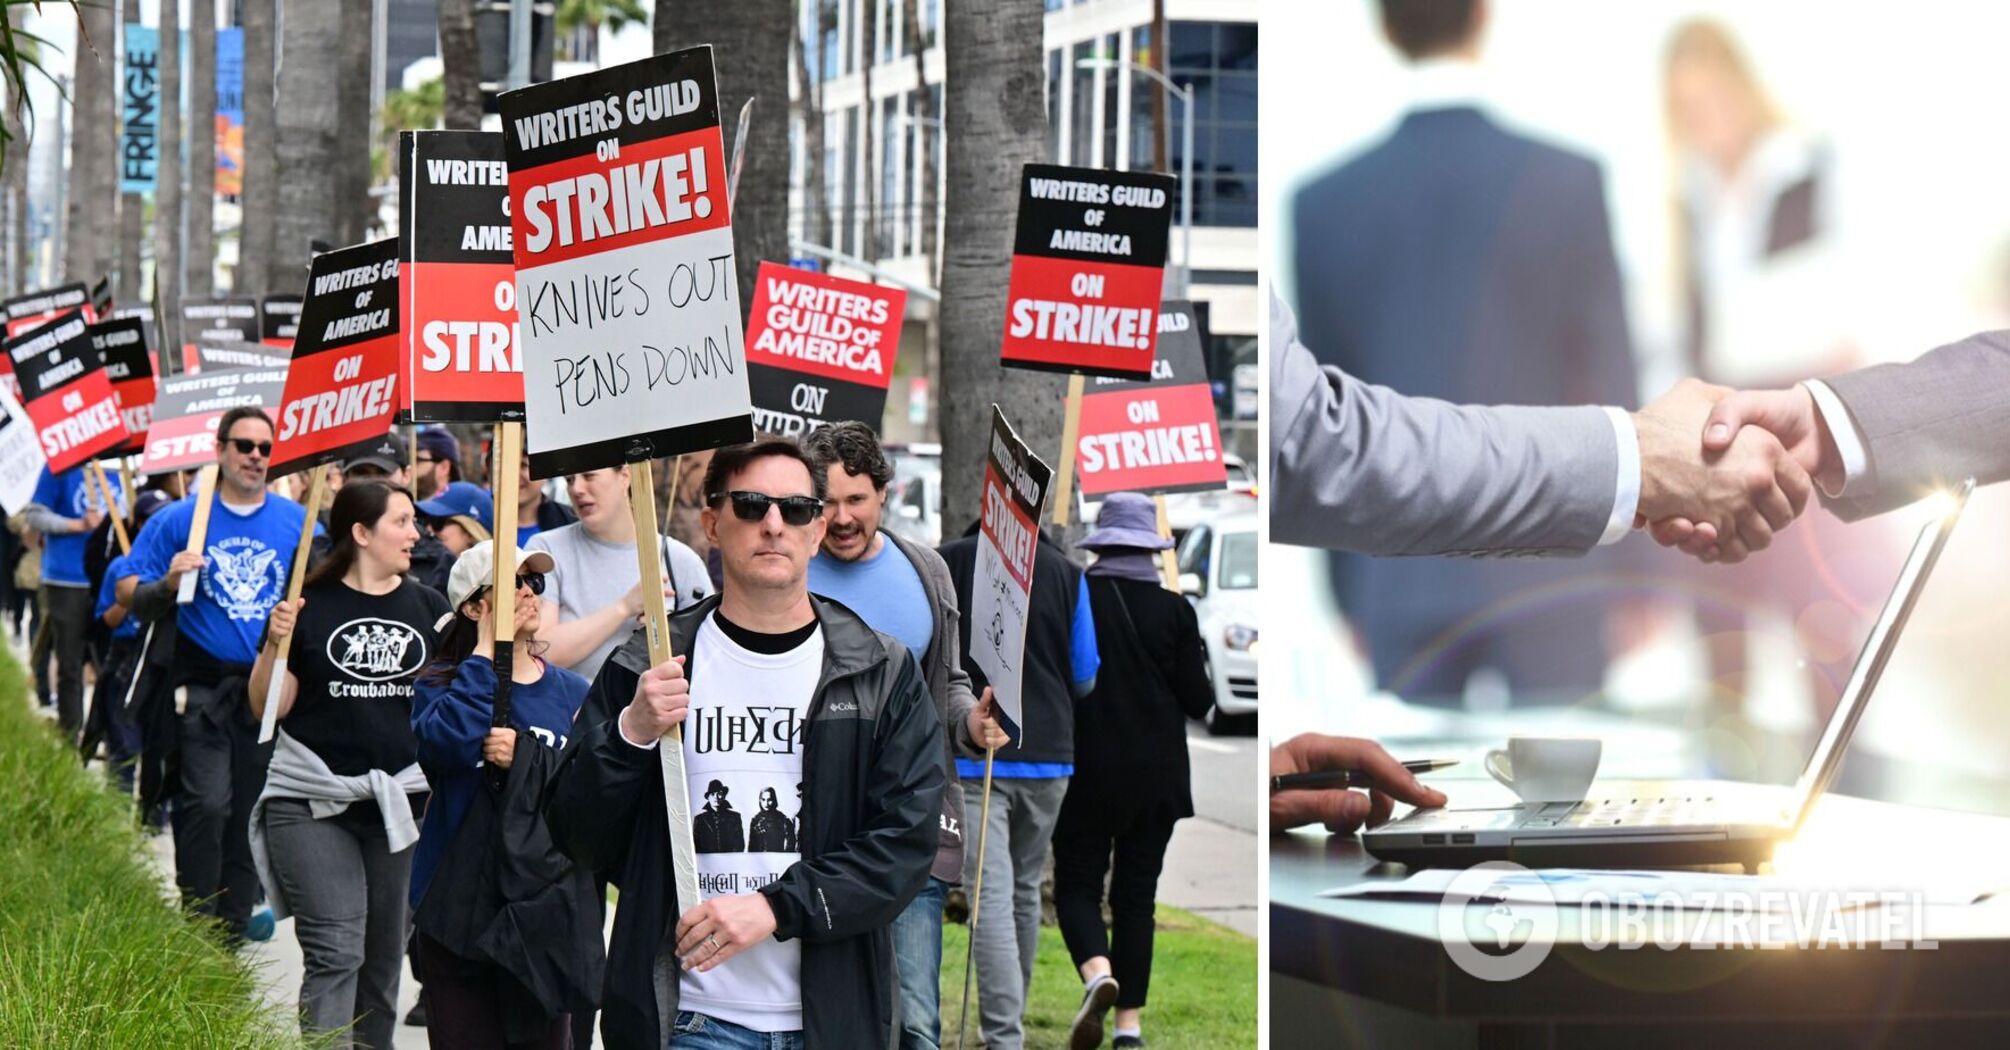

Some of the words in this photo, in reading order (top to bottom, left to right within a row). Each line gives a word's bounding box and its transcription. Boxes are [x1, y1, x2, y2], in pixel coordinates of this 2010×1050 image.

[125, 51, 156, 181] FRINGE
[515, 95, 622, 151] WRITERS
[626, 79, 701, 125] GUILD
[596, 138, 620, 162] ON
[427, 159, 508, 186] WRITE
[523, 146, 712, 253] STRIKE!
[1030, 178, 1110, 204] WRITERS
[1112, 185, 1166, 208] GUILD
[1084, 209, 1105, 226] OF
[1050, 229, 1131, 255] AMERICA
[314, 264, 380, 296] WRITERS
[494, 281, 518, 311] O
[527, 268, 649, 338] KNIVES
[668, 254, 732, 308] OUT
[1071, 272, 1105, 298] ON
[355, 290, 373, 309] OF
[767, 277, 889, 325] WRITERS
[323, 308, 390, 342] AMERICA
[766, 304, 853, 341] GUILD
[852, 327, 882, 348] OF
[1010, 299, 1152, 350] STRIKE!
[333, 354, 363, 382] ON
[754, 328, 883, 375] AMERICA
[165, 373, 240, 394] WRITERS
[554, 352, 630, 414] PENS
[642, 325, 734, 391] DOWN
[185, 394, 263, 413] AMERICA
[216, 386, 236, 396] OF
[279, 373, 397, 442] STRIKE!
[791, 383, 829, 415] ON
[40, 397, 120, 458] STRIKE!
[1127, 400, 1160, 424] ON
[1079, 422, 1217, 473] STRIKE!
[992, 428, 1017, 483] WRITERS
[1016, 466, 1040, 508] GUILD
[985, 480, 1032, 582] STRIKE!
